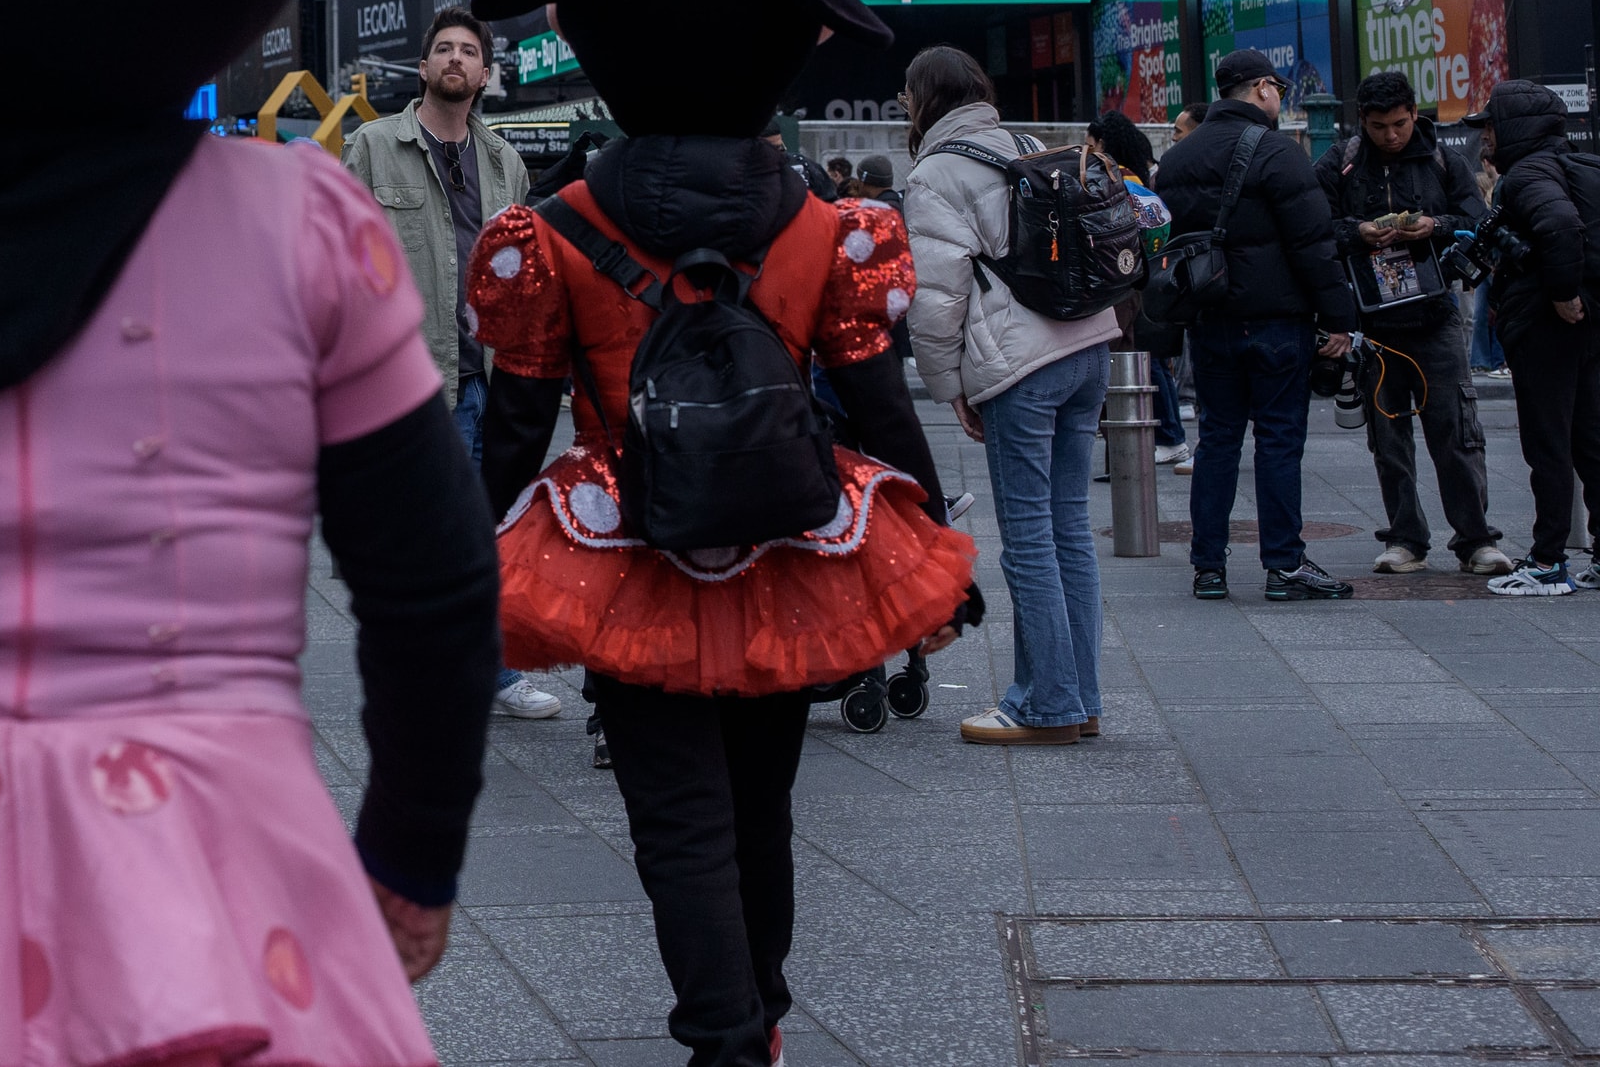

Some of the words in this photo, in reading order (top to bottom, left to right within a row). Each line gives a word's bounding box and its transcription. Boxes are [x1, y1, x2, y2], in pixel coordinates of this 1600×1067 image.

[262, 25, 292, 58] LEGORA
[1117, 35, 1130, 49] The
[1130, 18, 1179, 53] Brightest
[1366, 7, 1446, 63] times
[541, 38, 557, 75] Buy
[1139, 47, 1164, 80] Spot
[1165, 52, 1180, 73] on
[1369, 53, 1470, 105] uare
[1152, 81, 1181, 108] Earth
[1565, 98, 1586, 108] OVING
[1566, 88, 1584, 97] ZONE
[825, 99, 906, 121] one
[502, 128, 536, 140] Times
[1444, 137, 1467, 146] WAY
[1567, 132, 1587, 141] THIS
[512, 141, 546, 154] ubway
